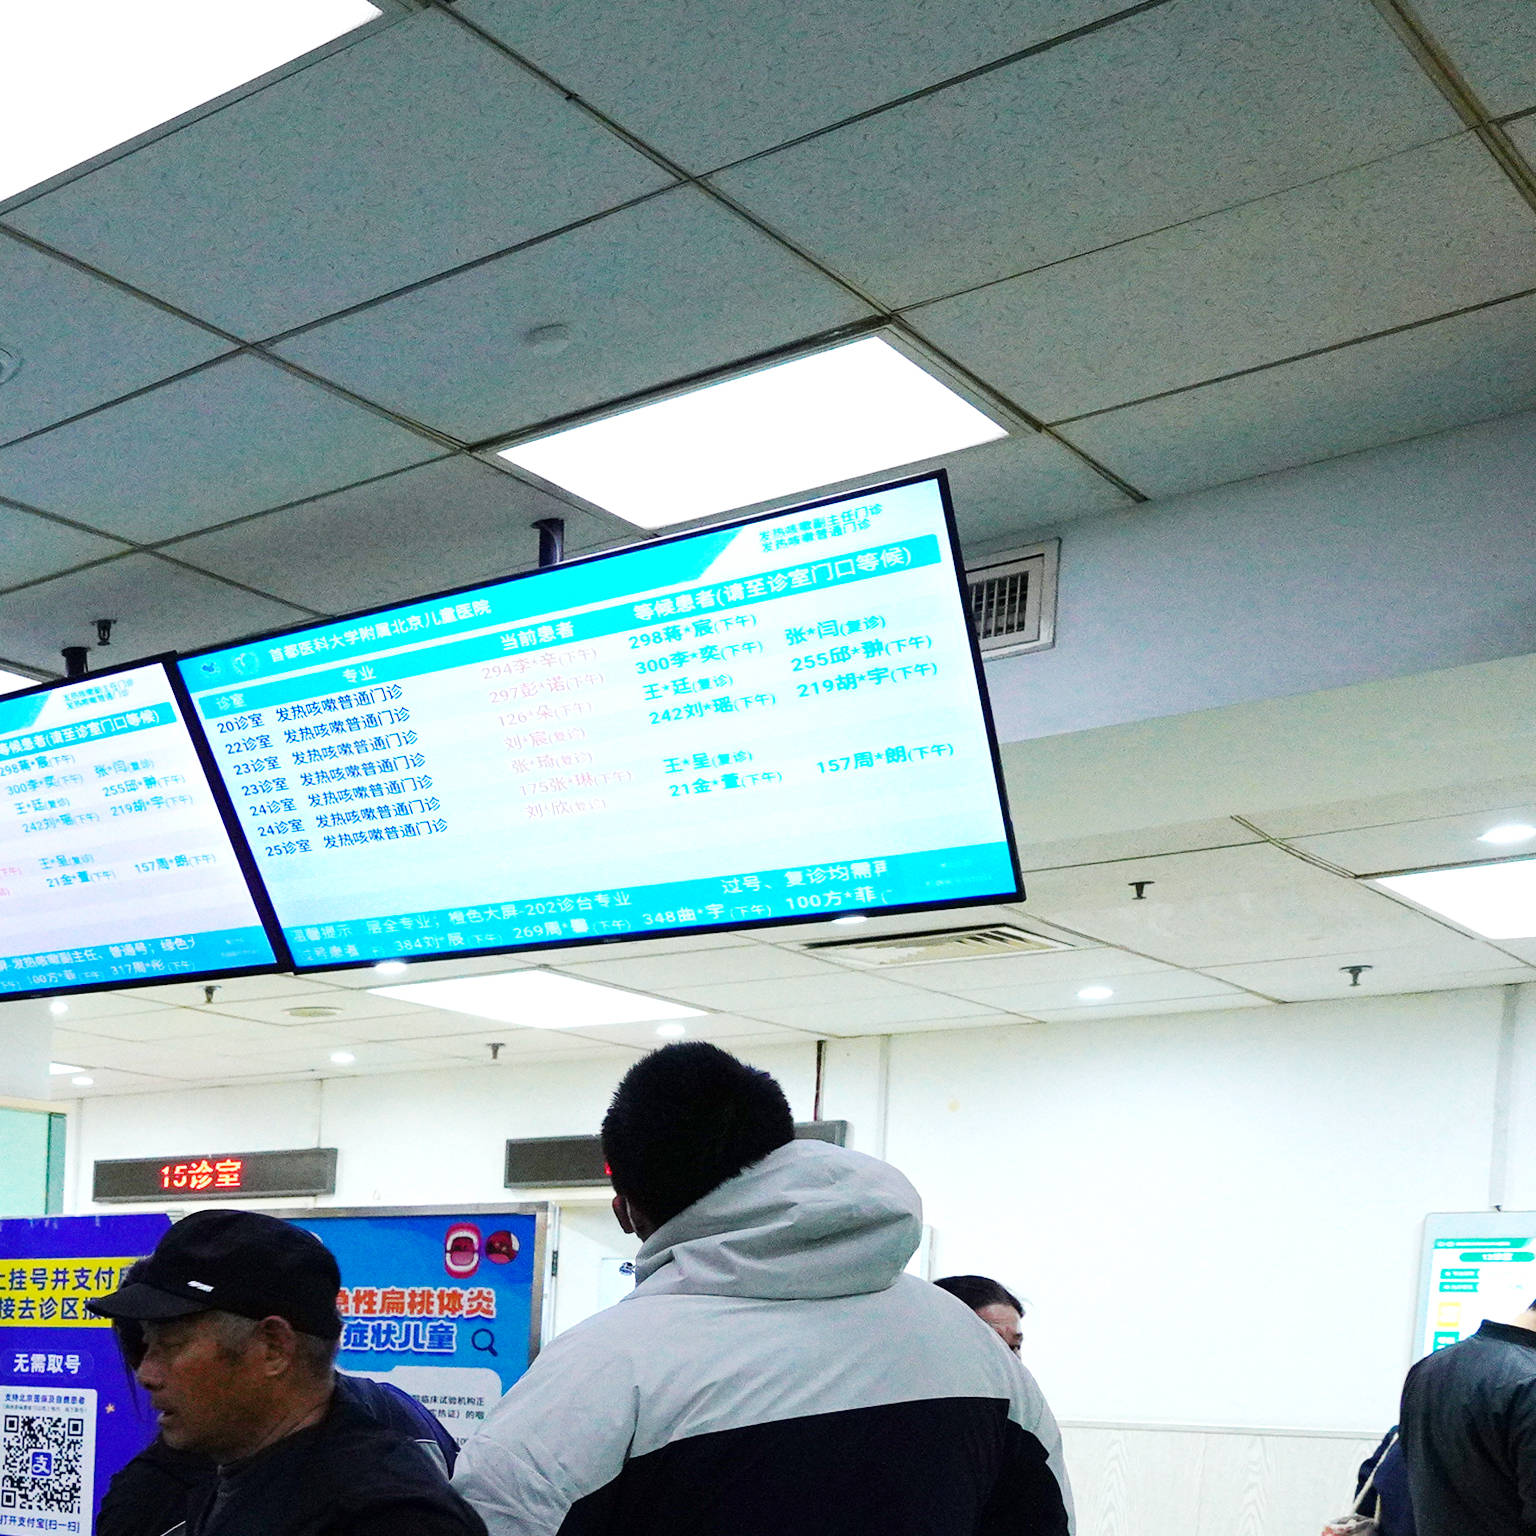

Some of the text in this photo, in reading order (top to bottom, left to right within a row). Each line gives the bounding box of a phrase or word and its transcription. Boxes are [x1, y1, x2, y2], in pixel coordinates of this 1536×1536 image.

[267, 598, 492, 663] 首都医科大学附属北京儿童医院
[214, 692, 247, 711] 诊室
[341, 664, 377, 684] 专业
[499, 619, 576, 651] 当前患者
[215, 712, 266, 735] 20诊室
[273, 683, 405, 723] 发热咳嗽普通门诊
[223, 733, 273, 755] 22诊室
[281, 705, 412, 744] 发热咳嗽普通门诊
[231, 755, 281, 776] 23诊室
[289, 728, 420, 765] 发热咳嗽普通门诊
[239, 776, 289, 797] 23诊室
[297, 751, 428, 787] 发热咳嗽普通门诊
[247, 797, 297, 817] 24诊室
[305, 773, 435, 808] 发热咳嗽普通门诊
[255, 817, 305, 838] 24诊室
[312, 795, 442, 829] 发热咳嗽普通门诊
[262, 838, 312, 857] 25诊室
[320, 817, 449, 849] 发热咳嗽普通门诊
[161, 1159, 242, 1190] 15诊室
[14, 1354, 81, 1374] 无需取号
